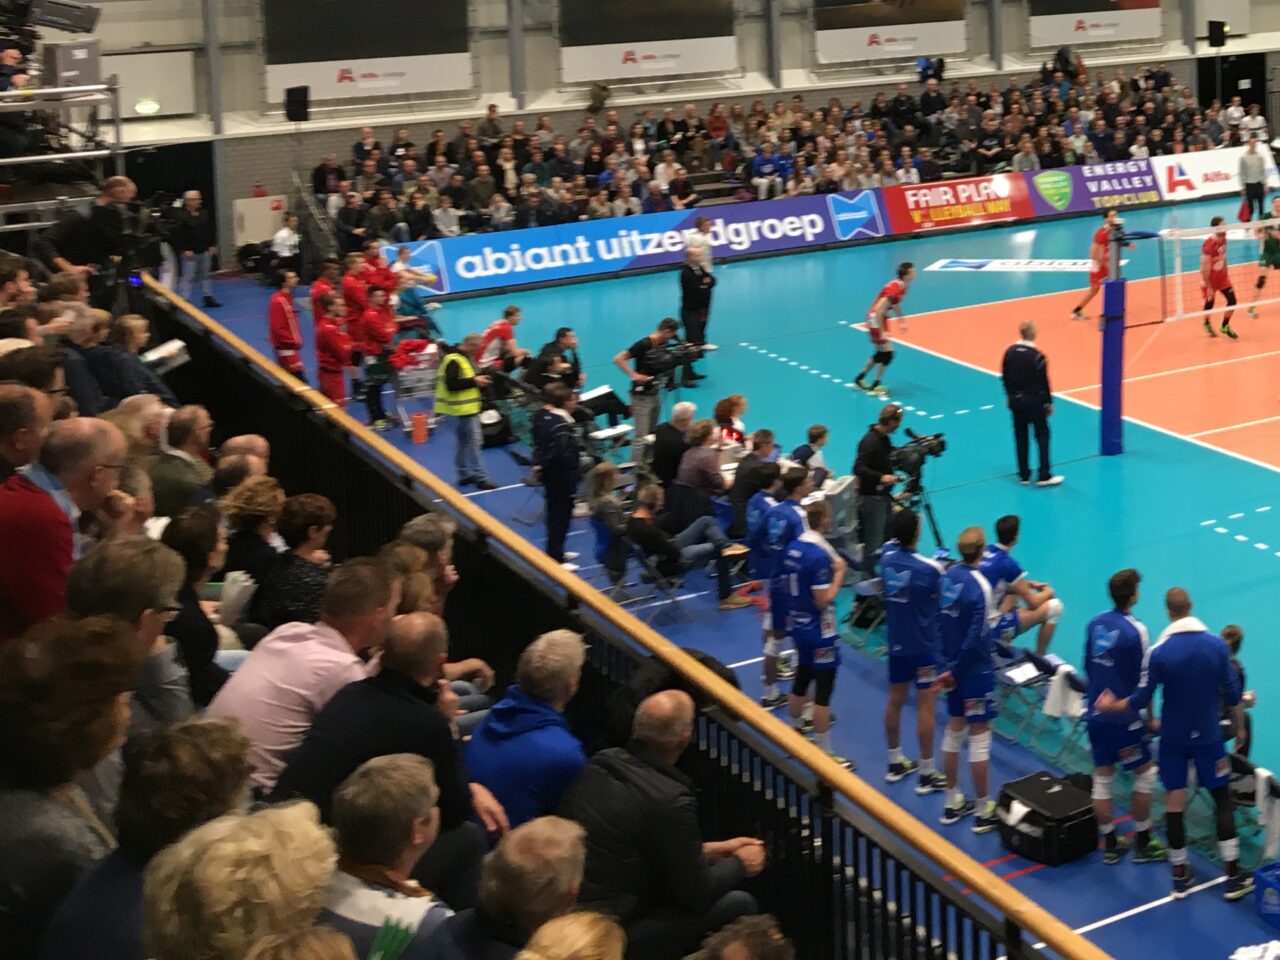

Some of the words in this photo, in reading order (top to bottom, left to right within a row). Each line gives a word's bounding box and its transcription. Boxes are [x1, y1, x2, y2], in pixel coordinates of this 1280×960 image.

[1081, 159, 1148, 177] ENERGY
[1086, 175, 1154, 193] VALLEY
[904, 186, 956, 209] FAIR
[956, 180, 1009, 203] PLA
[1090, 190, 1160, 208] TOPCLUB
[455, 235, 595, 279] abiant
